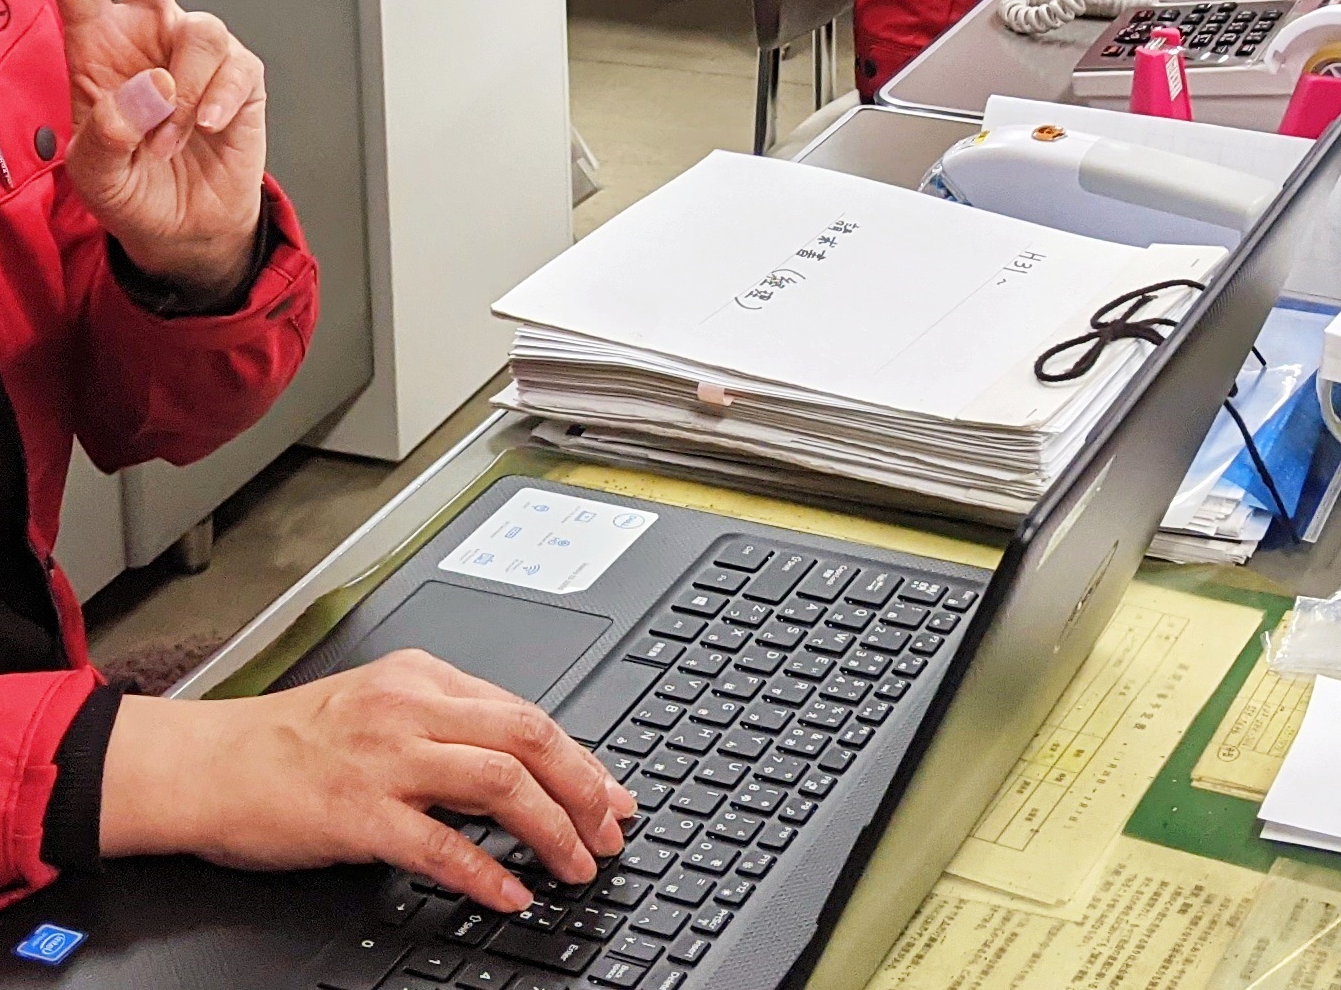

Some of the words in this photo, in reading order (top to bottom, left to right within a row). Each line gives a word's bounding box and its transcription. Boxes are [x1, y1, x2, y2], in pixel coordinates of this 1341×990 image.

[834, 634, 848, 643] W
[640, 731, 655, 740] N
[699, 729, 713, 737] H
[841, 751, 853, 759] F7
[616, 759, 630, 768] M
[729, 763, 742, 771] U
[821, 776, 831, 784] F8
[652, 784, 666, 792] K
[779, 827, 791, 838] F10
[659, 850, 670, 858] P
[758, 855, 770, 864] F11
[736, 882, 749, 893] F12
[455, 922, 473, 936] Shift
[561, 944, 578, 961] Enter
[685, 940, 704, 957] Insert
